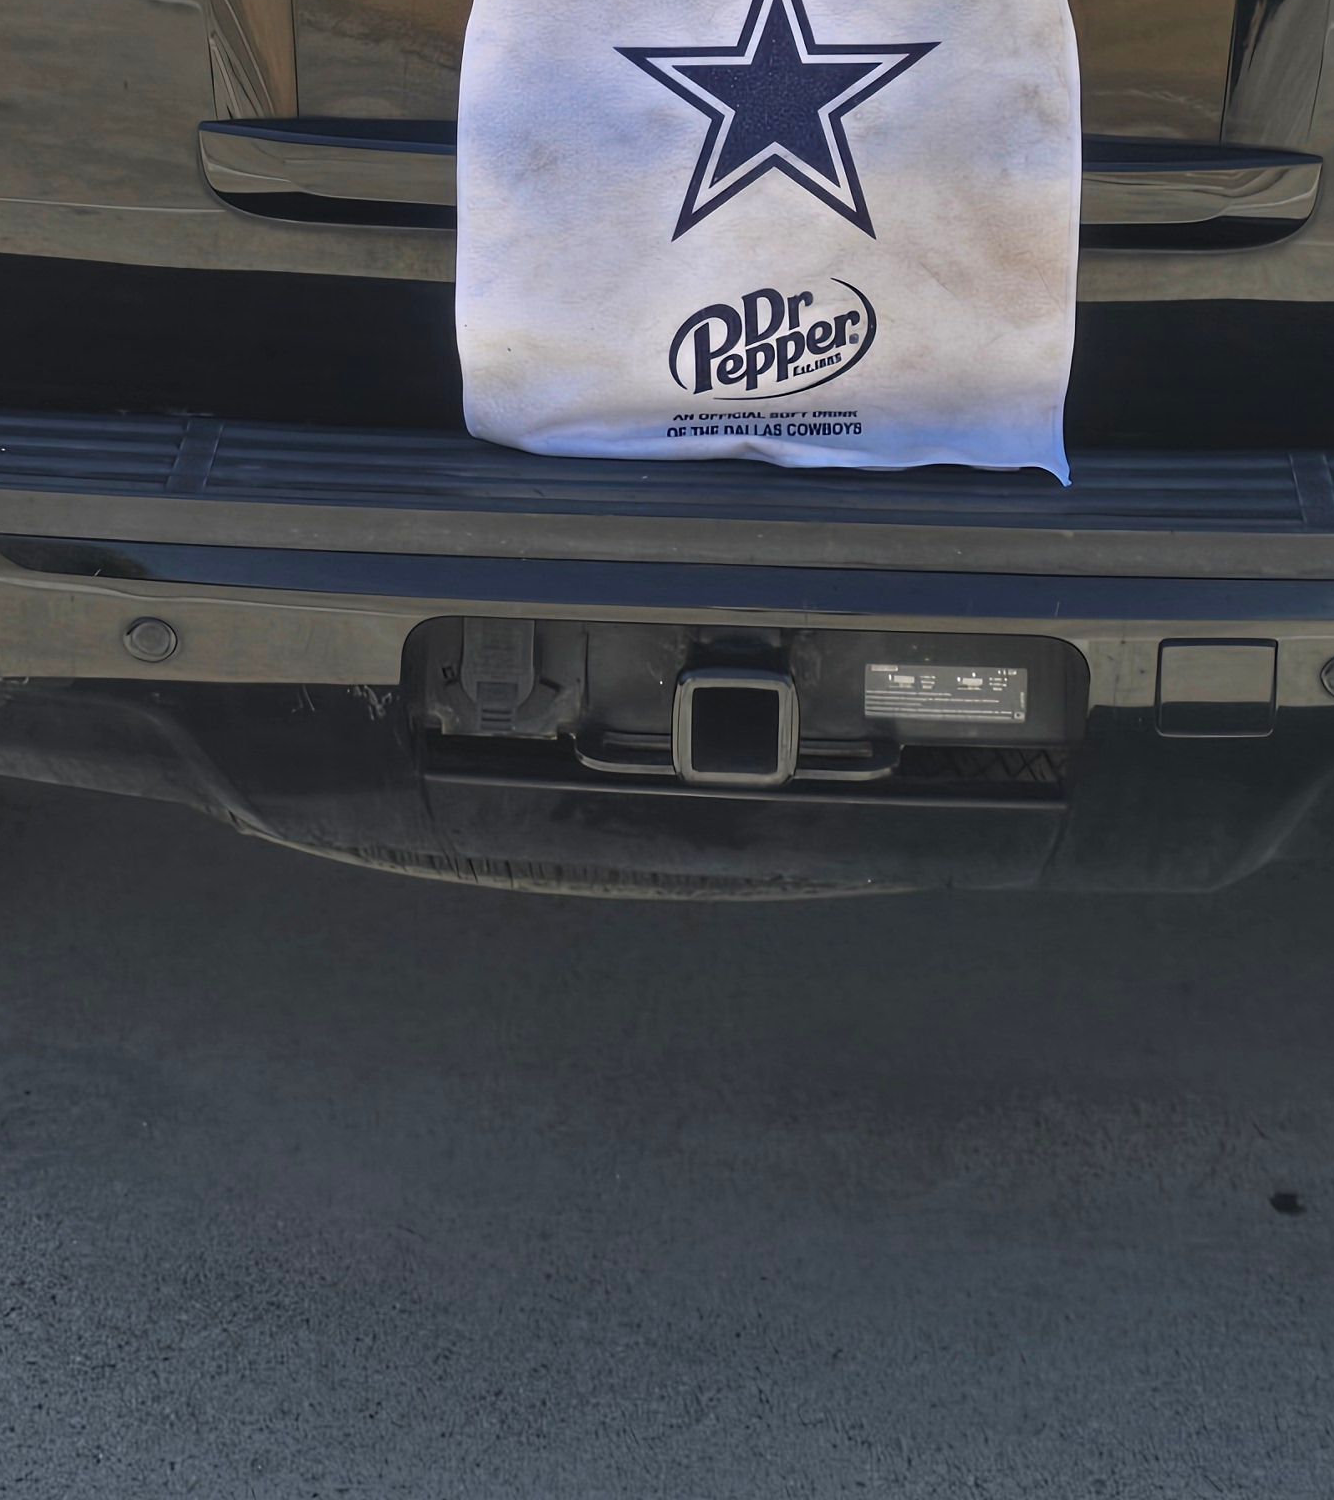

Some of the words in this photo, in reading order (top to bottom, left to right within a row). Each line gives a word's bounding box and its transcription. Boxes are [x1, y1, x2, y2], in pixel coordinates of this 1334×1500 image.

[741, 288, 814, 347] Dr
[724, 423, 782, 437] DALLAS
[787, 421, 863, 436] COWBOYS
